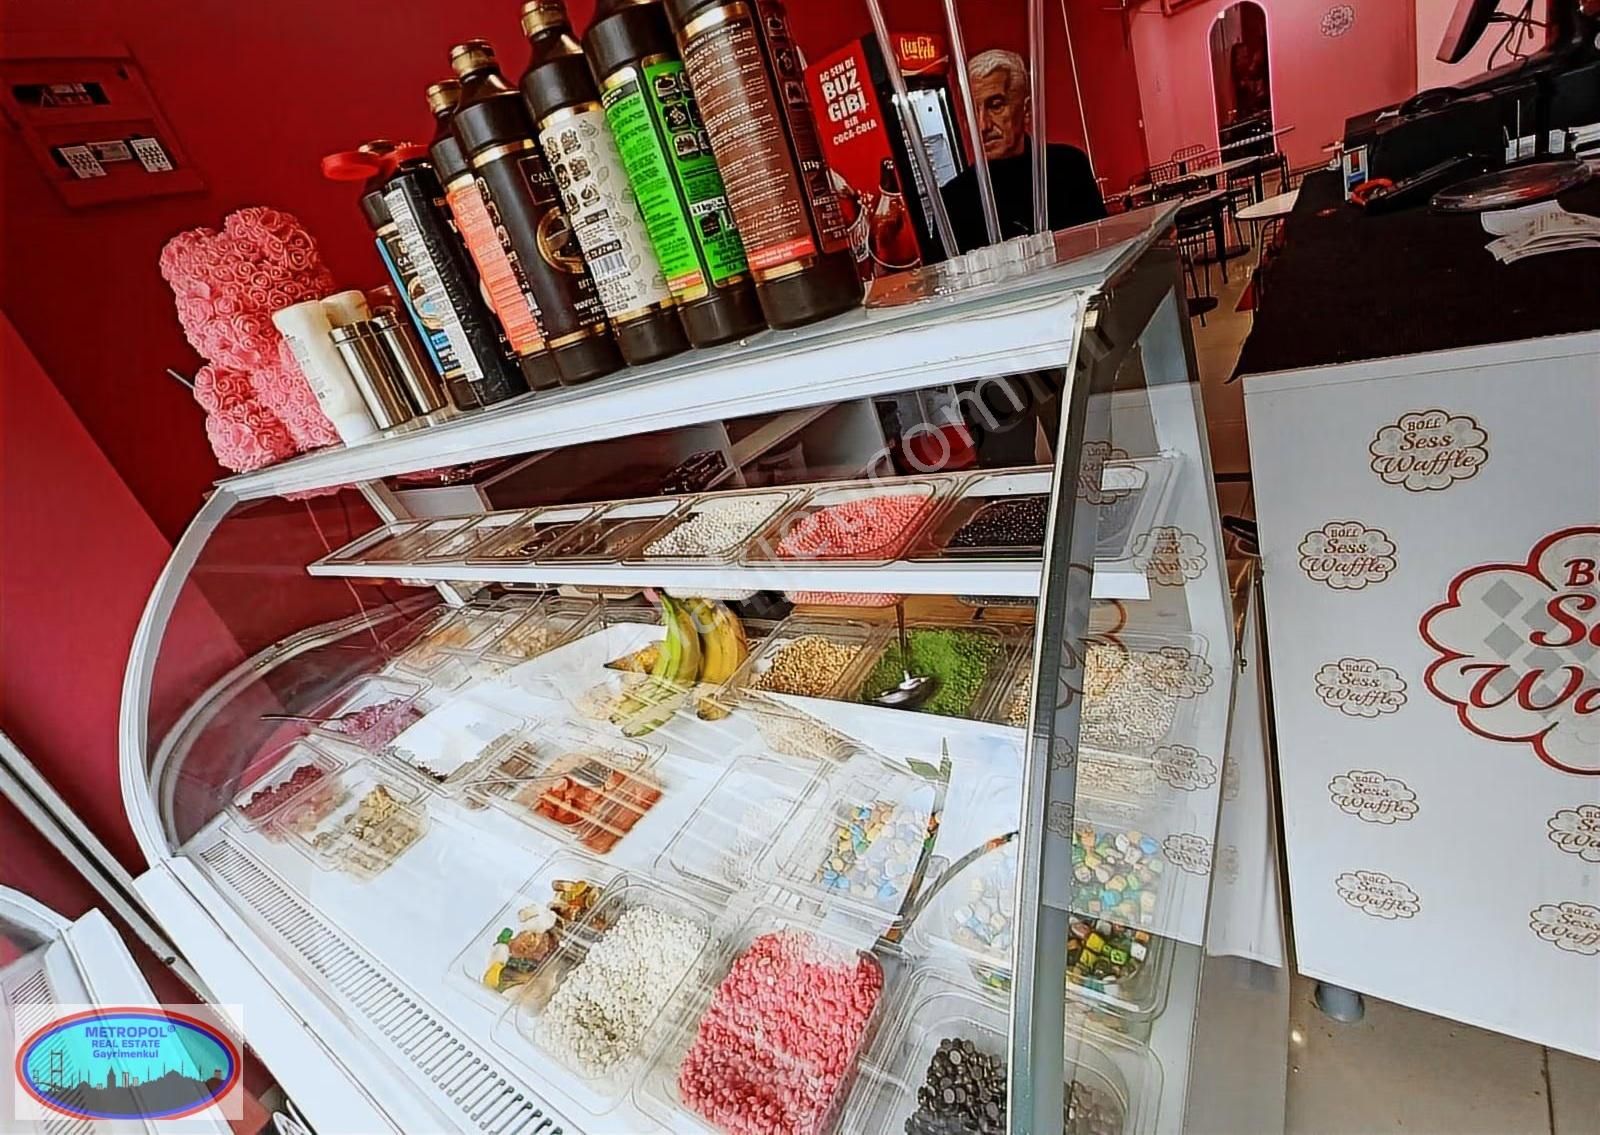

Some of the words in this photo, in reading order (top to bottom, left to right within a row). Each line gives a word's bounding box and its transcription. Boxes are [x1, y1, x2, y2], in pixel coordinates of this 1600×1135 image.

[821, 68, 861, 104] BUZ
[1406, 417, 1441, 431] BOLL
[1399, 432, 1454, 451] Sess
[1380, 449, 1476, 476] Waffle
[1324, 538, 1368, 554] Sess
[1308, 557, 1386, 576] Waffle
[1323, 686, 1397, 706] Waffle
[1338, 796, 1410, 814] Waffle
